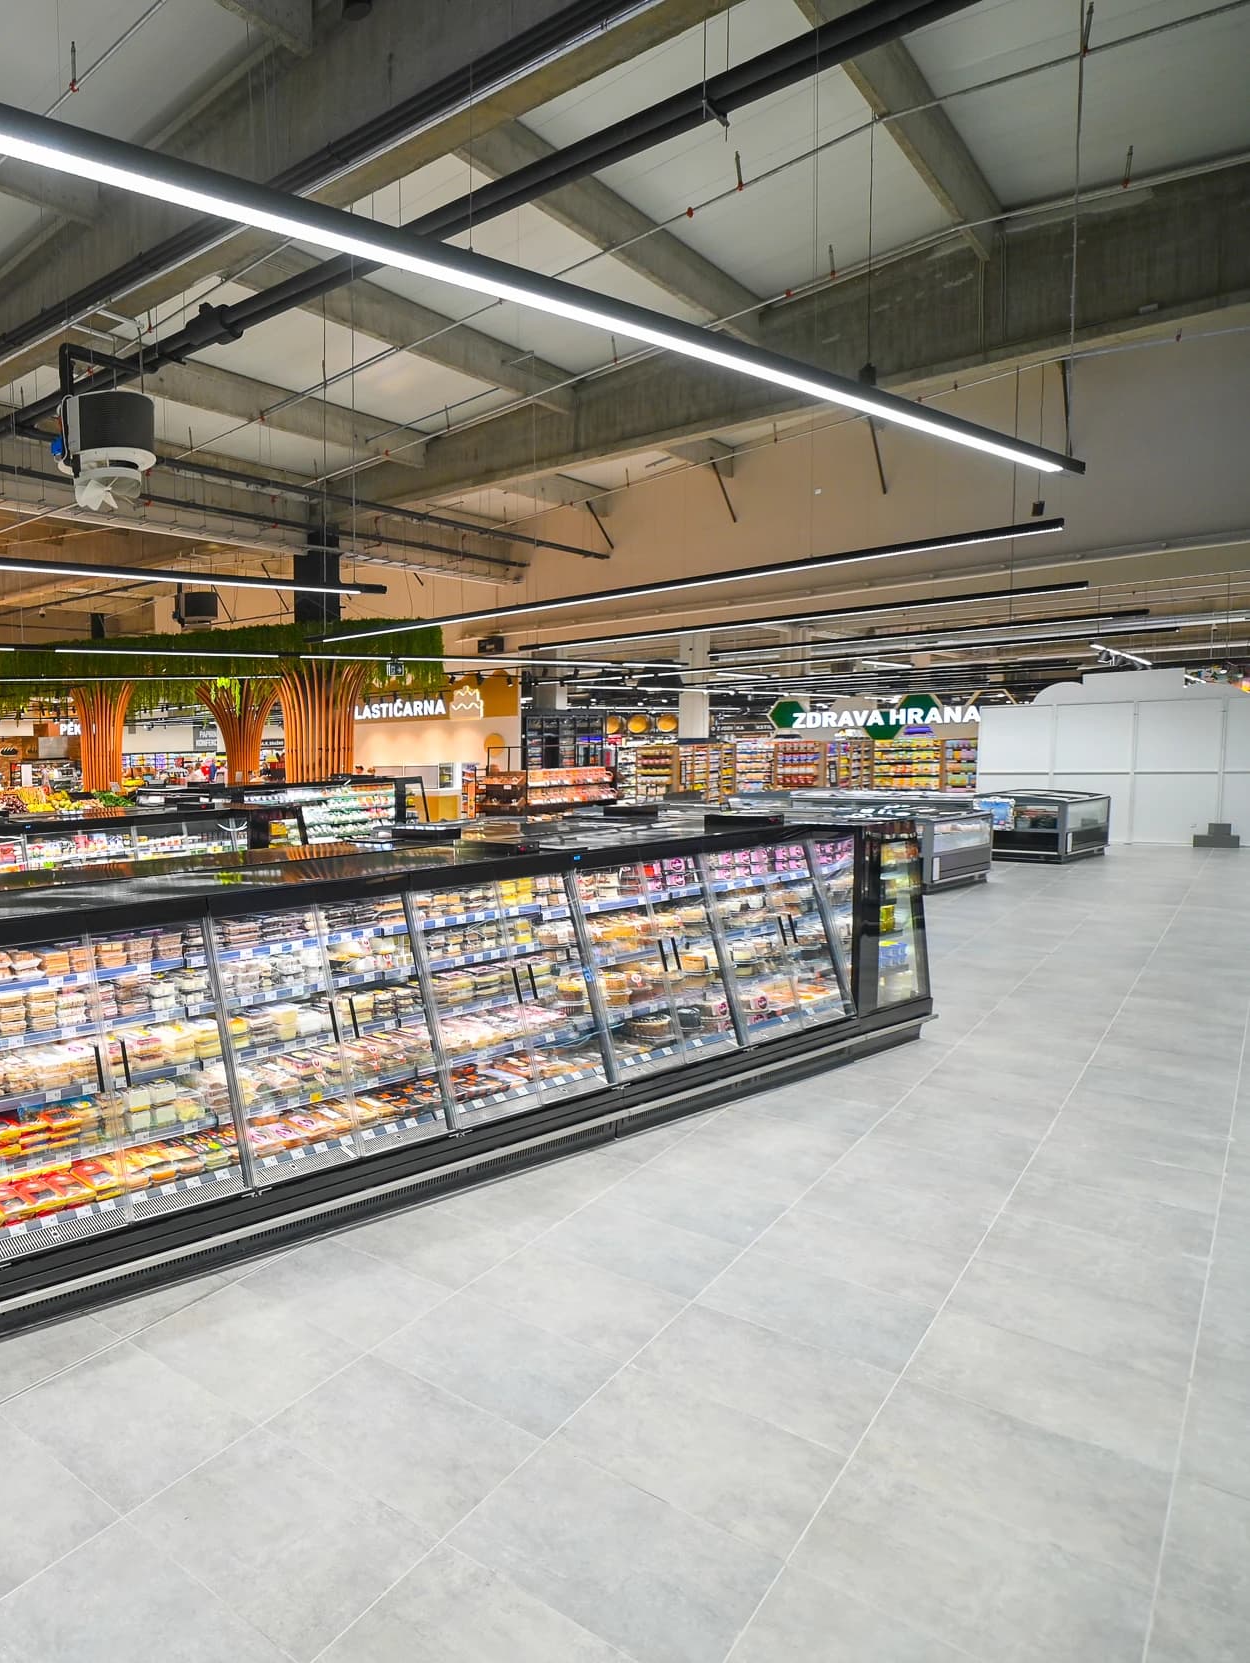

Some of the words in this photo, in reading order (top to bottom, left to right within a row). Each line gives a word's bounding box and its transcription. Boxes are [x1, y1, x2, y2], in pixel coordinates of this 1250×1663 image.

[354, 699, 446, 720] LASTIČARNA
[792, 709, 885, 729] ZDRAVA
[889, 705, 981, 726] HRANA
